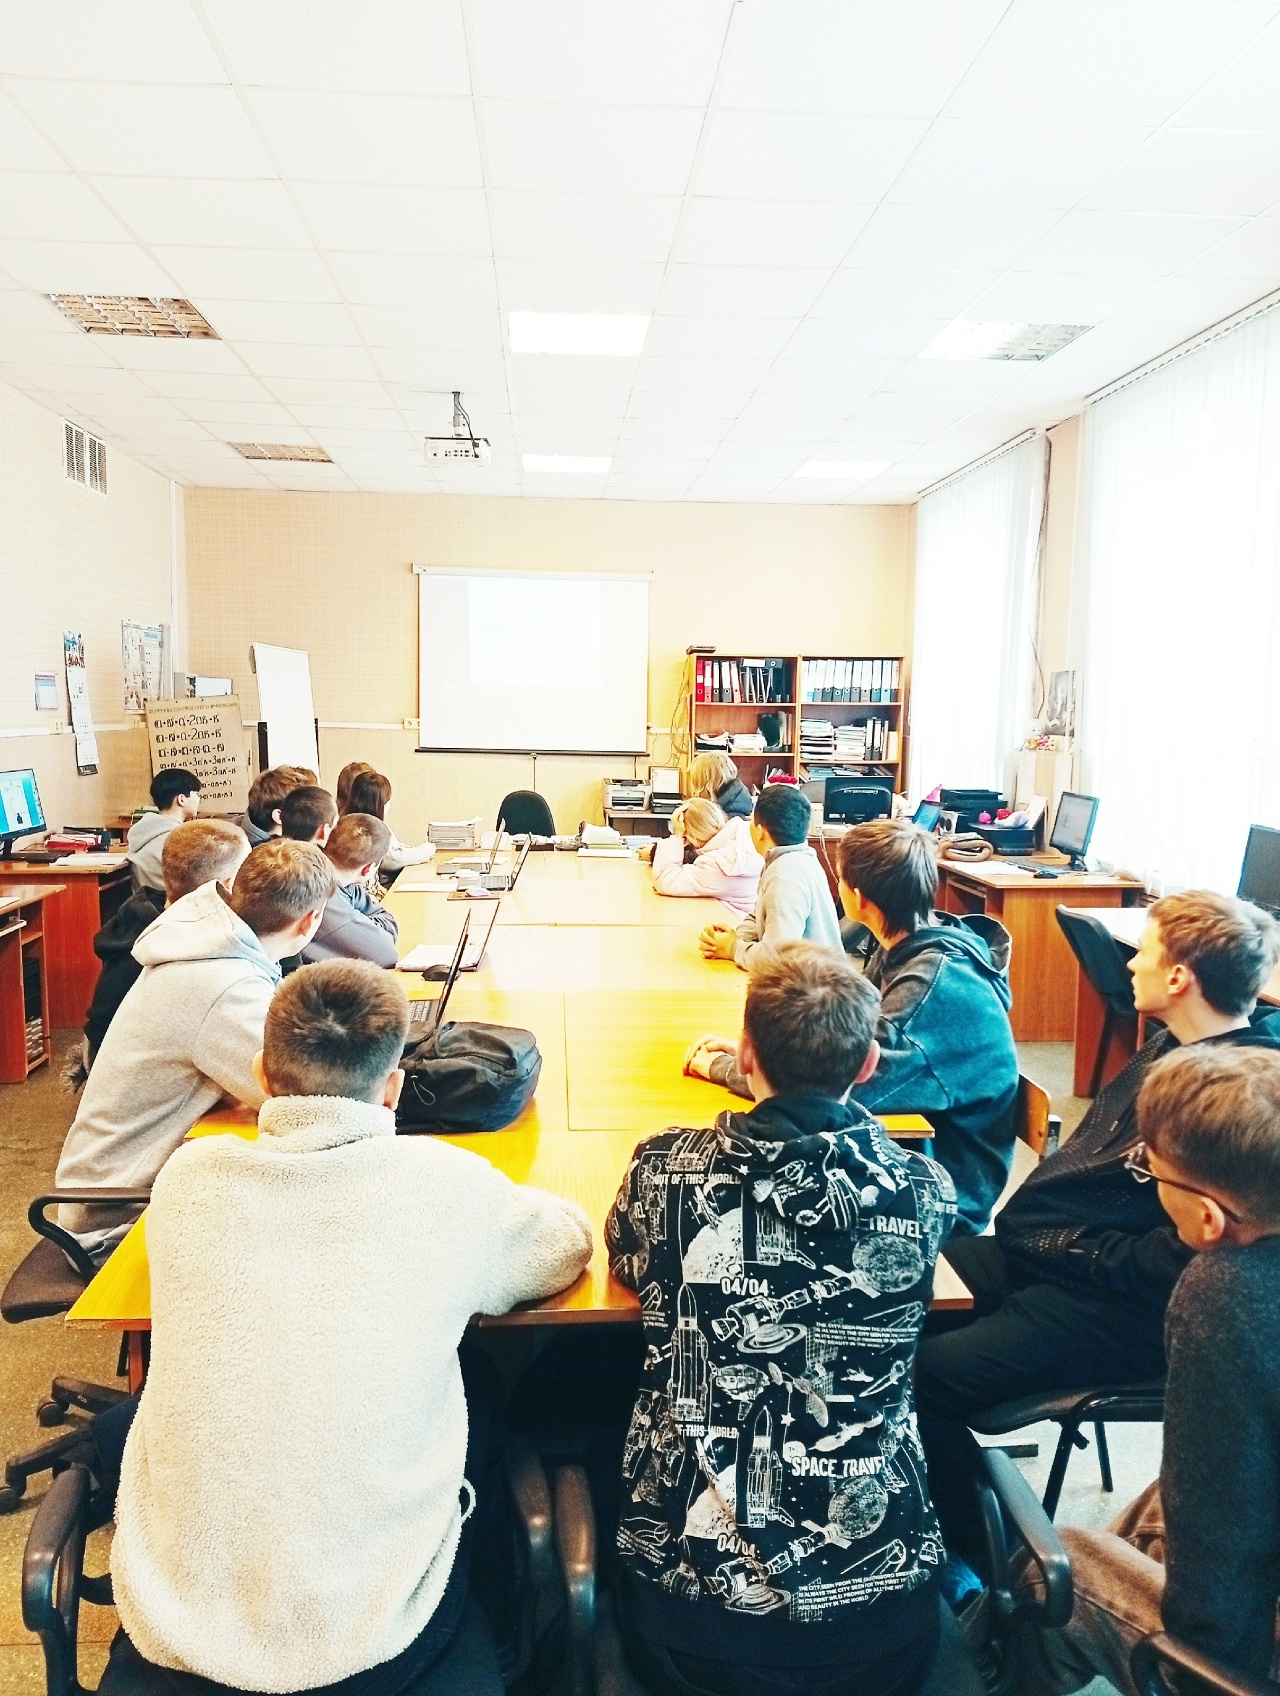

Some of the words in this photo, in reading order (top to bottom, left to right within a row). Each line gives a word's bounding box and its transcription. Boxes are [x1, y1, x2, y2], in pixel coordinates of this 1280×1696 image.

[671, 1173, 683, 1185] OF
[685, 1173, 705, 1185] THIS
[721, 1277, 769, 1297] 04/04
[685, 1424, 705, 1437] THIS
[708, 1425, 739, 1439] WORLD
